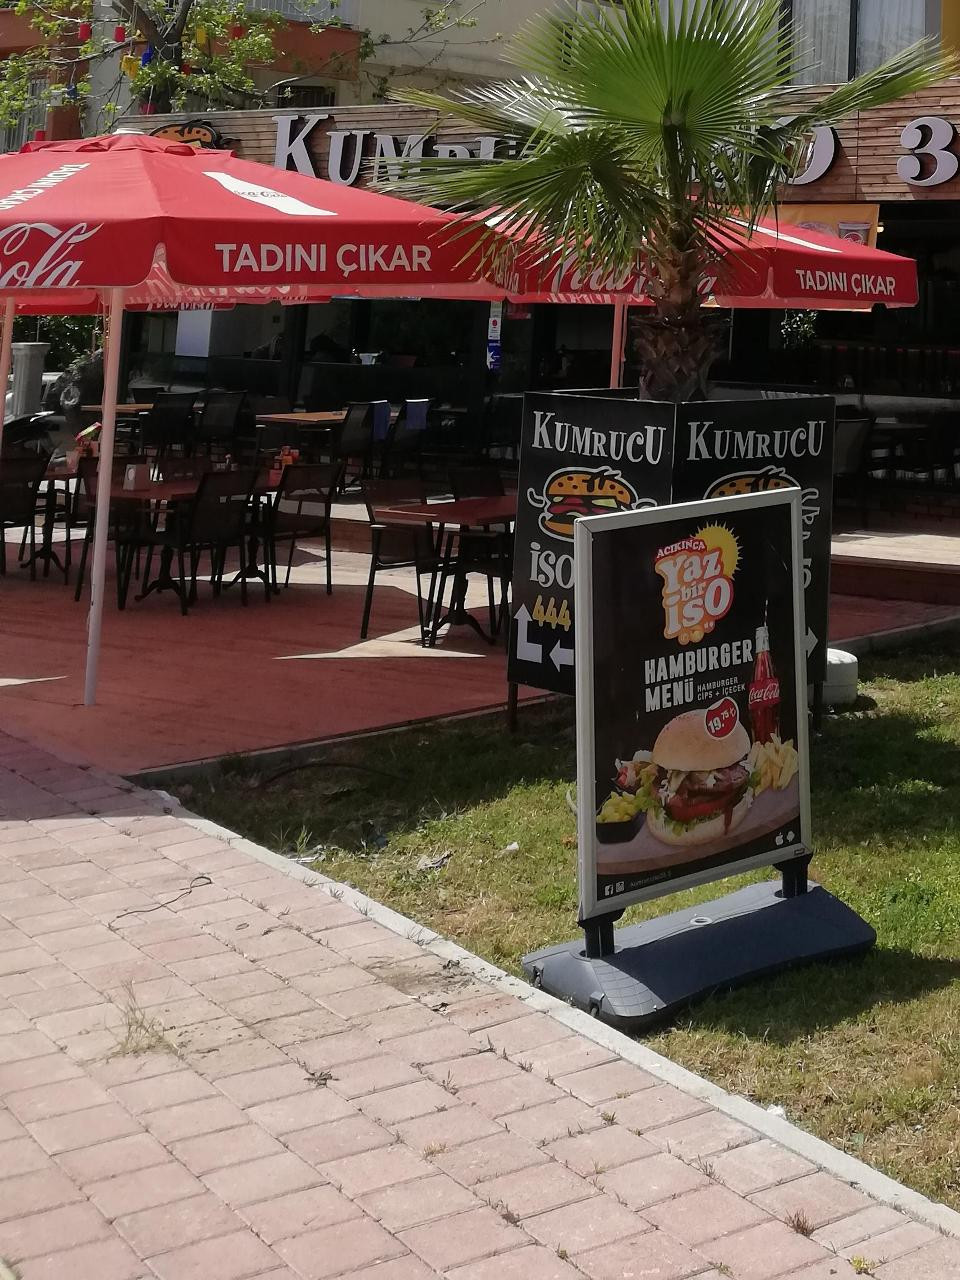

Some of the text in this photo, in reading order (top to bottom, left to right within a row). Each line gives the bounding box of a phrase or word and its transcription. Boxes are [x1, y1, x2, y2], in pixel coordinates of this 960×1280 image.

[215, 243, 432, 277] TADINI ÇIKAR
[795, 269, 896, 297] TADINI ÇIKAR
[532, 411, 666, 464] KUMRUCU
[687, 421, 826, 461] KUMRUCU
[659, 551, 721, 593] Yaz
[532, 595, 572, 631] 444
[644, 639, 753, 685] HAMBURGER
[645, 678, 694, 713] MENÜ
[697, 676, 739, 692] HAMBURGER
